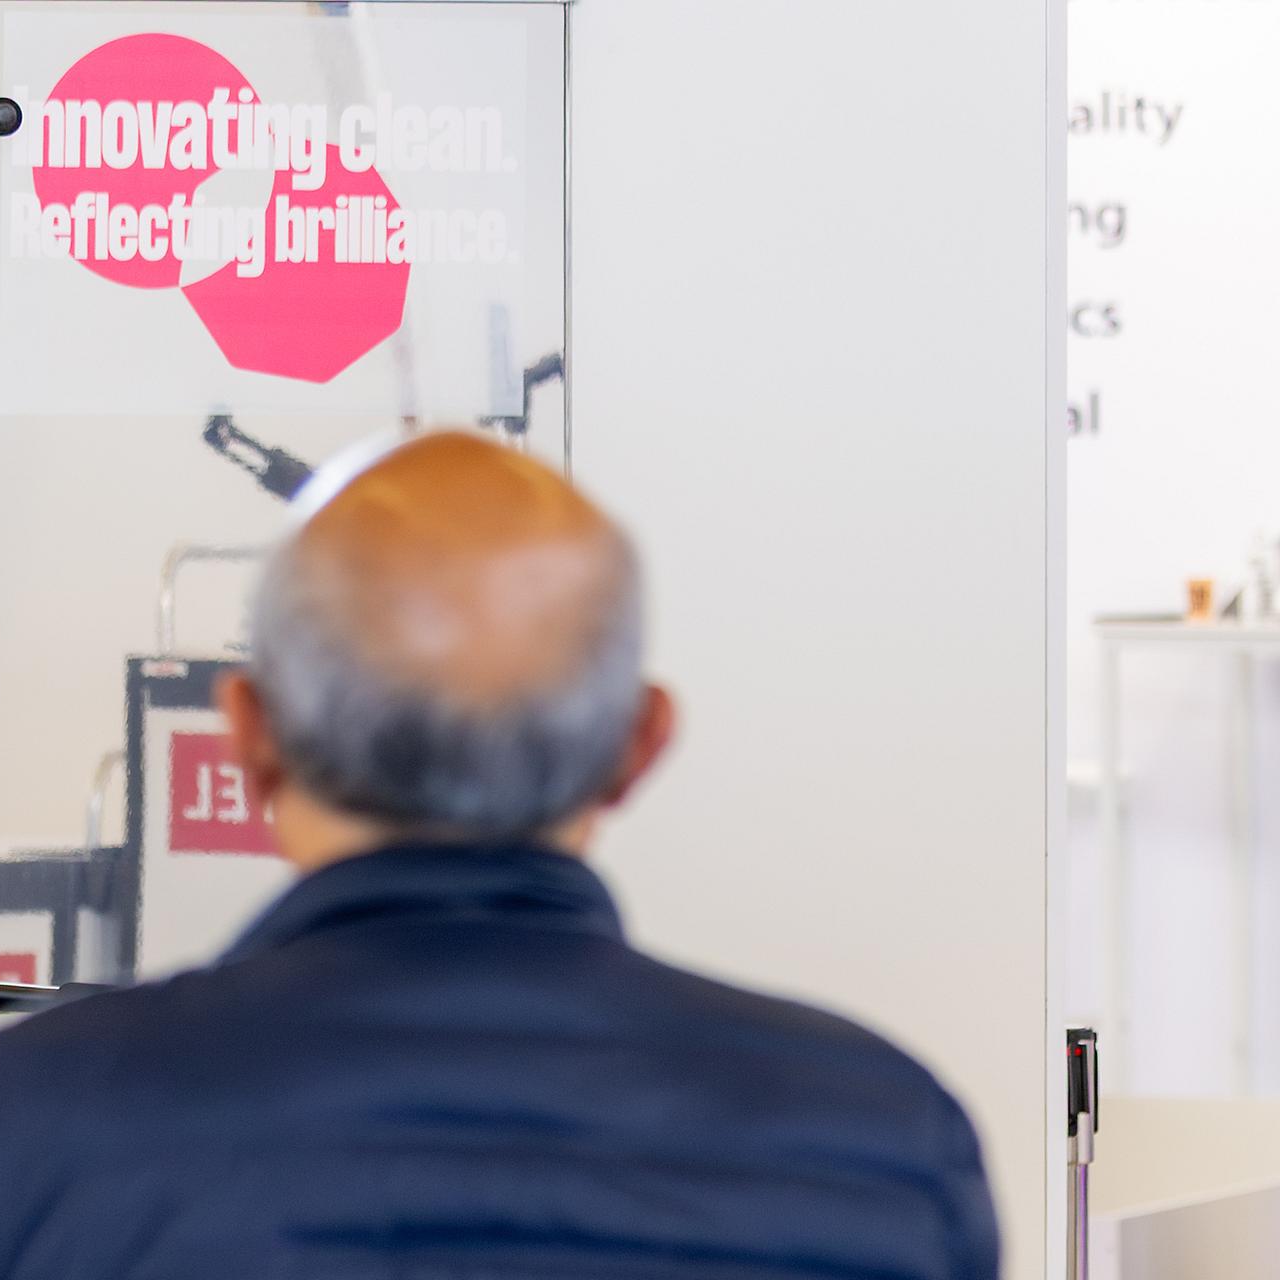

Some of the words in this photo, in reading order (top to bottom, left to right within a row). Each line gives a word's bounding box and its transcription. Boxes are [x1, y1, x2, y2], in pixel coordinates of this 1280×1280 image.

[10, 85, 327, 189] Innovating
[339, 92, 518, 171] clean.
[9, 192, 265, 277] Reflecting
[276, 196, 520, 264] brilliance.
